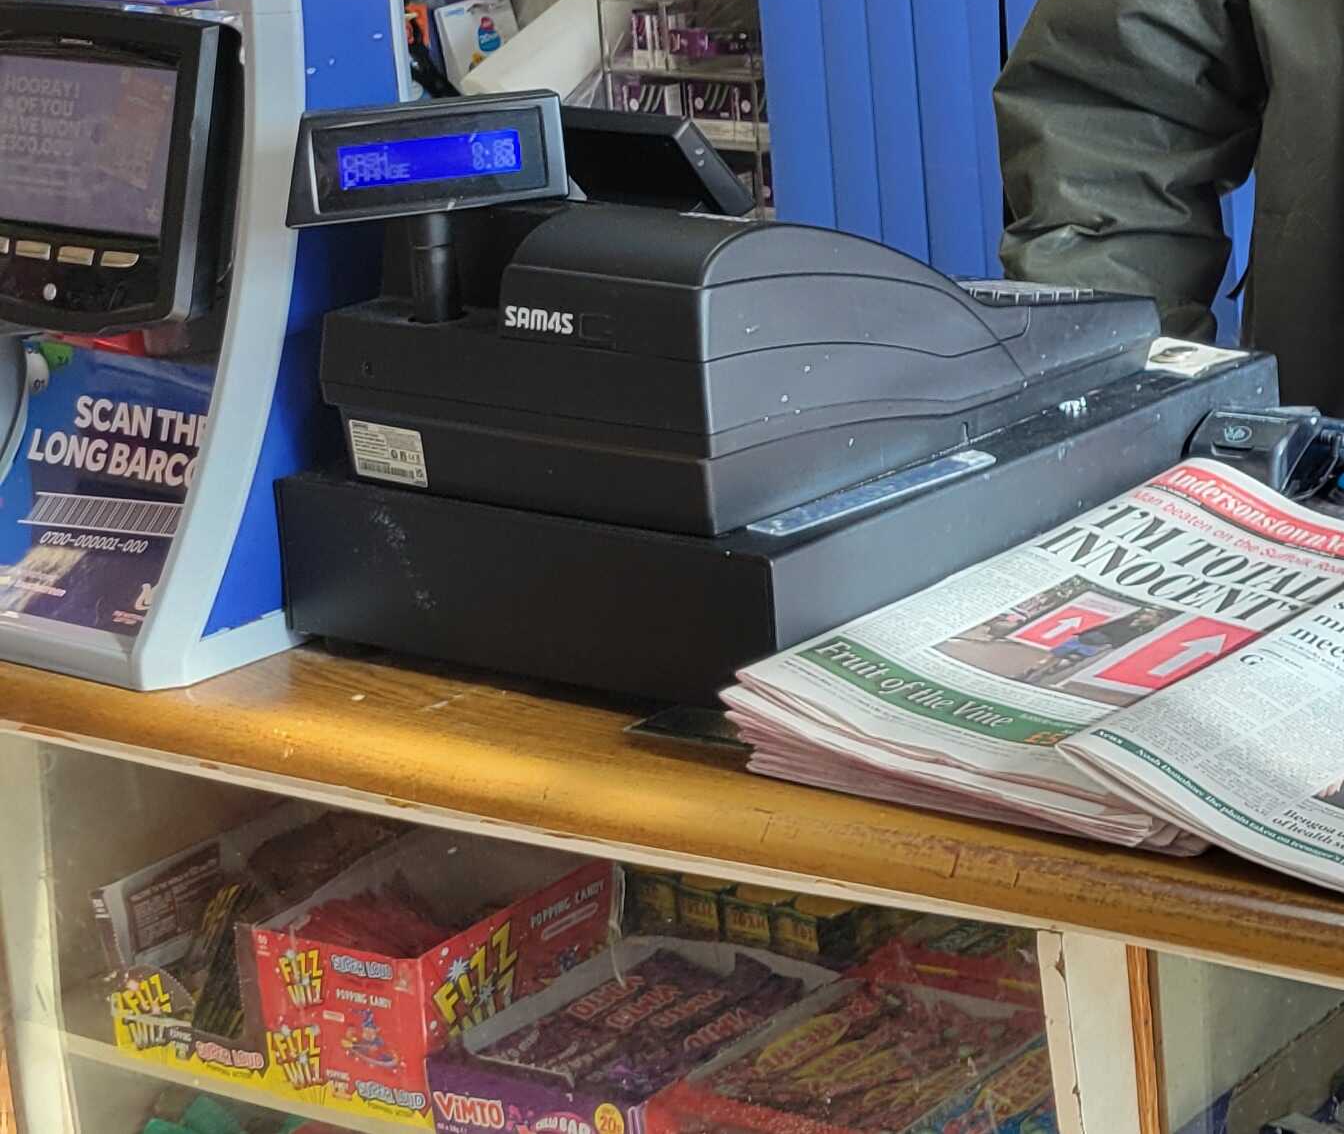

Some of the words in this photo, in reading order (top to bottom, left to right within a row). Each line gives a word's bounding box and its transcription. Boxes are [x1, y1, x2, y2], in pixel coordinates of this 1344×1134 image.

[343, 153, 389, 171] CASH
[343, 164, 411, 183] CHANGE
[504, 306, 574, 334] SAM4S
[74, 396, 153, 435] SCAN
[27, 427, 108, 473] LONG
[815, 640, 884, 684] Fruit
[915, 681, 952, 718] the
[952, 698, 1014, 730] Vine
